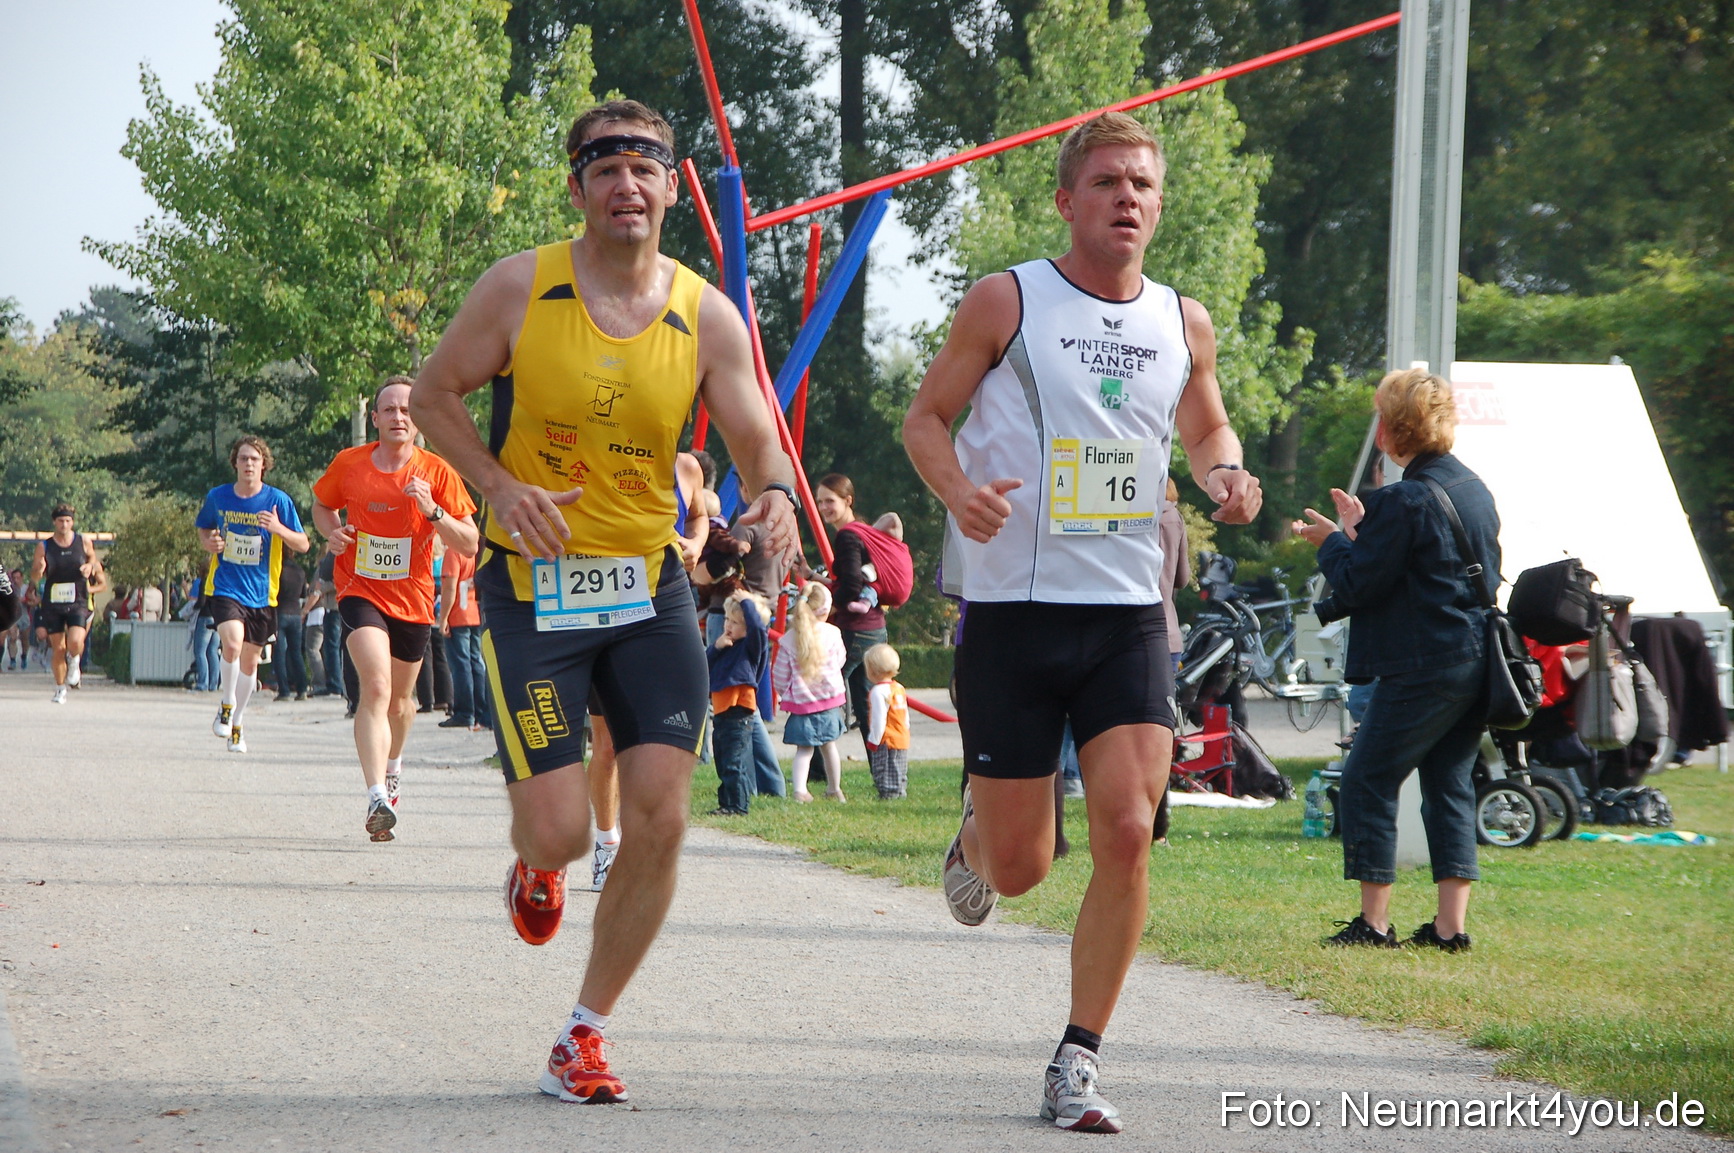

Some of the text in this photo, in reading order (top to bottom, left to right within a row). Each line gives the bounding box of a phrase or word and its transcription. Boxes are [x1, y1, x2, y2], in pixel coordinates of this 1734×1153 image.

[1077, 339, 1158, 361] INTERSPORT
[1081, 352, 1145, 372] LANGE
[1089, 366, 1133, 379] AMBERG
[545, 419, 578, 430] Schreinerei
[546, 427, 577, 445] Seidl
[1085, 446, 1134, 464] Florian
[612, 469, 651, 483] PIZZERIA
[1057, 474, 1064, 488] A
[618, 480, 647, 490] ELIO
[1105, 476, 1136, 502] 16
[225, 510, 260, 519] NEUMARK
[1120, 518, 1153, 528] PFLEIDERER
[369, 539, 399, 549] Norbert
[237, 547, 255, 556] 816
[374, 553, 401, 566] 906
[541, 571, 549, 584] A
[569, 565, 636, 595] 2913
[610, 606, 652, 620] PFLEIDERER
[534, 687, 565, 732] Run!
[525, 711, 544, 745] Team
[663, 718, 693, 730] adidas
